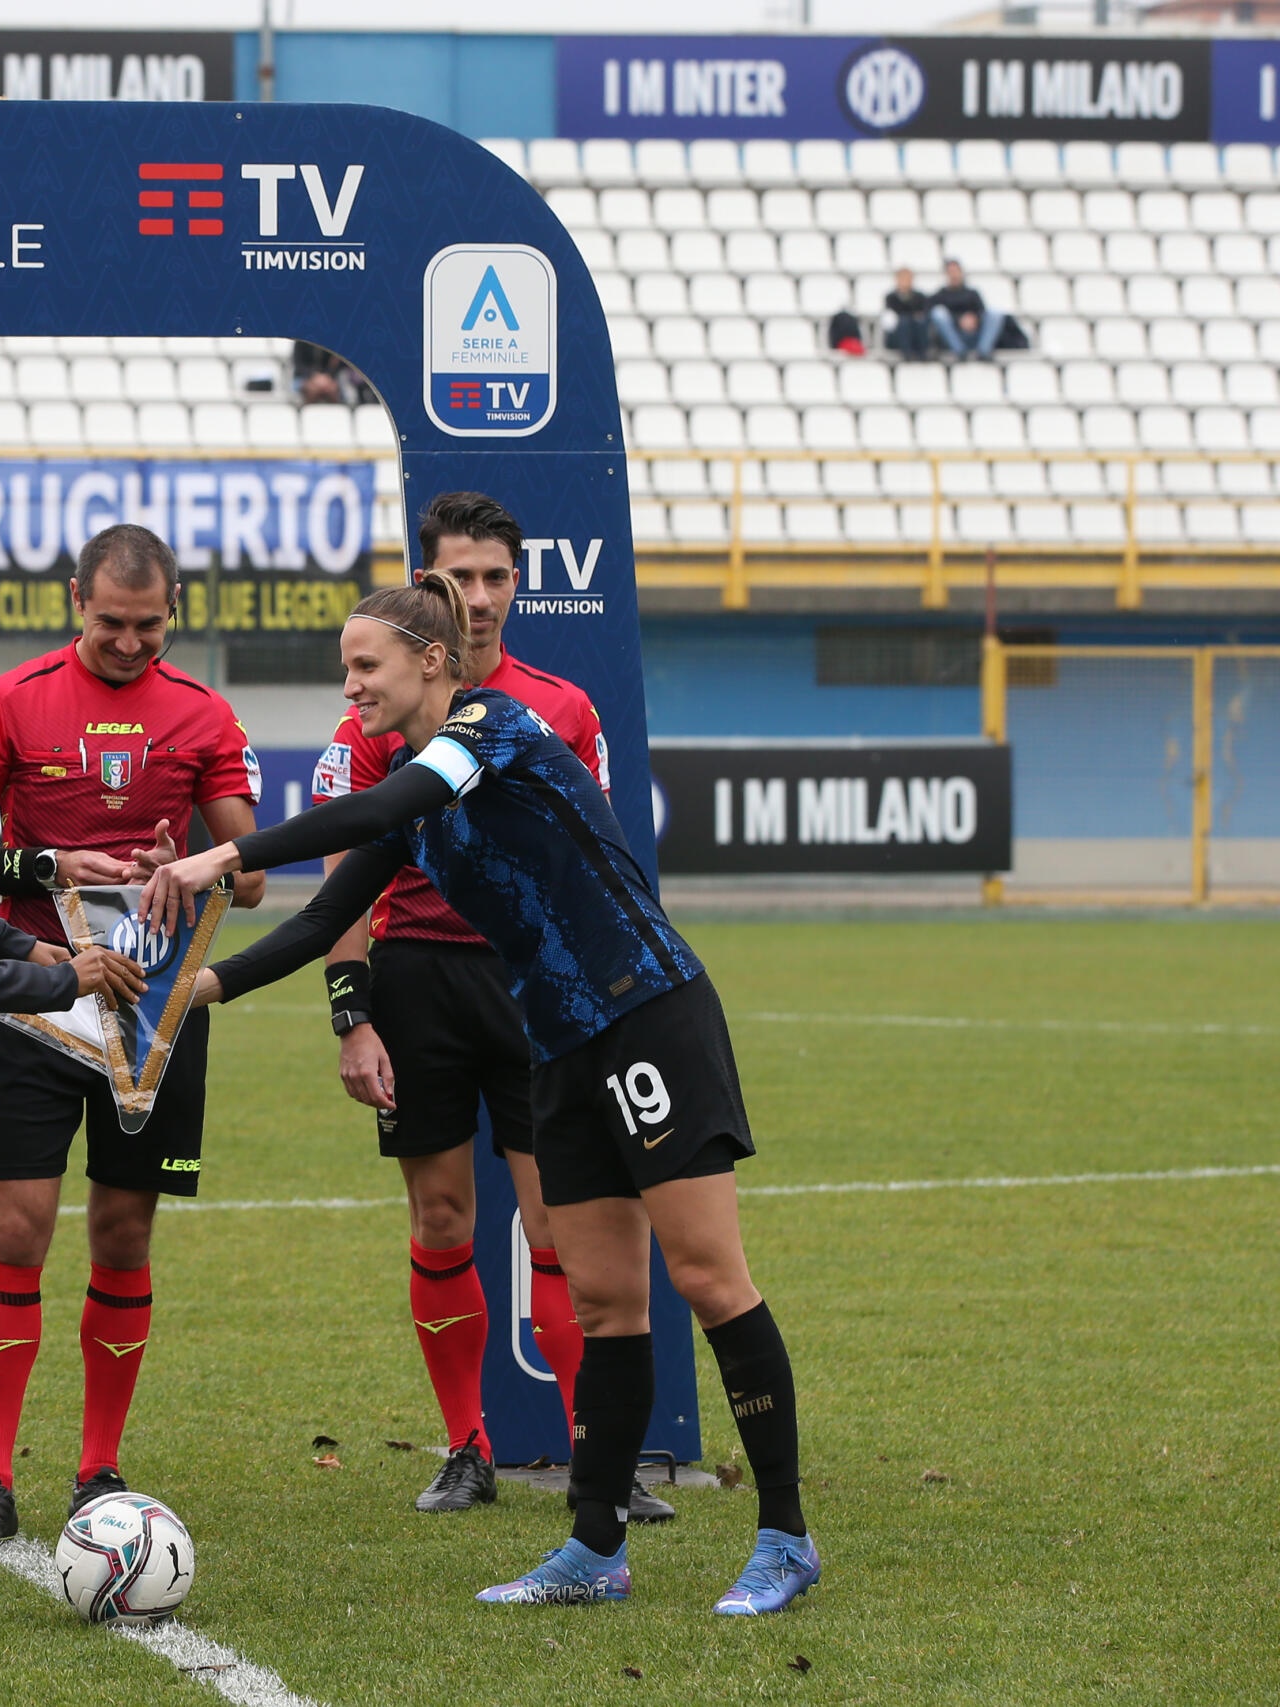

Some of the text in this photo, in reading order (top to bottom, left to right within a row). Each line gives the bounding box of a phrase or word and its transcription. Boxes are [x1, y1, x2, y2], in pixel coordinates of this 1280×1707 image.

[4, 54, 42, 100] M
[50, 54, 204, 101] MILANO
[604, 60, 786, 116] I M INTER
[964, 60, 1182, 119] I M MILANO
[241, 163, 365, 237] TV
[241, 250, 365, 271] TIMVISION
[462, 338, 518, 349] SERIE A
[452, 351, 529, 364] FEMMINILE
[486, 382, 530, 409] TV
[486, 412, 531, 421] TIMVISION
[521, 538, 603, 591] TV
[515, 600, 604, 615] TIMVISION
[85, 722, 145, 735] LEGEA
[716, 777, 976, 843] I M MILANO
[606, 1061, 671, 1137] 19
[161, 1157, 201, 1172] LEGE
[734, 1394, 774, 1418] INTER
[99, 1516, 127, 1530] FINAL
